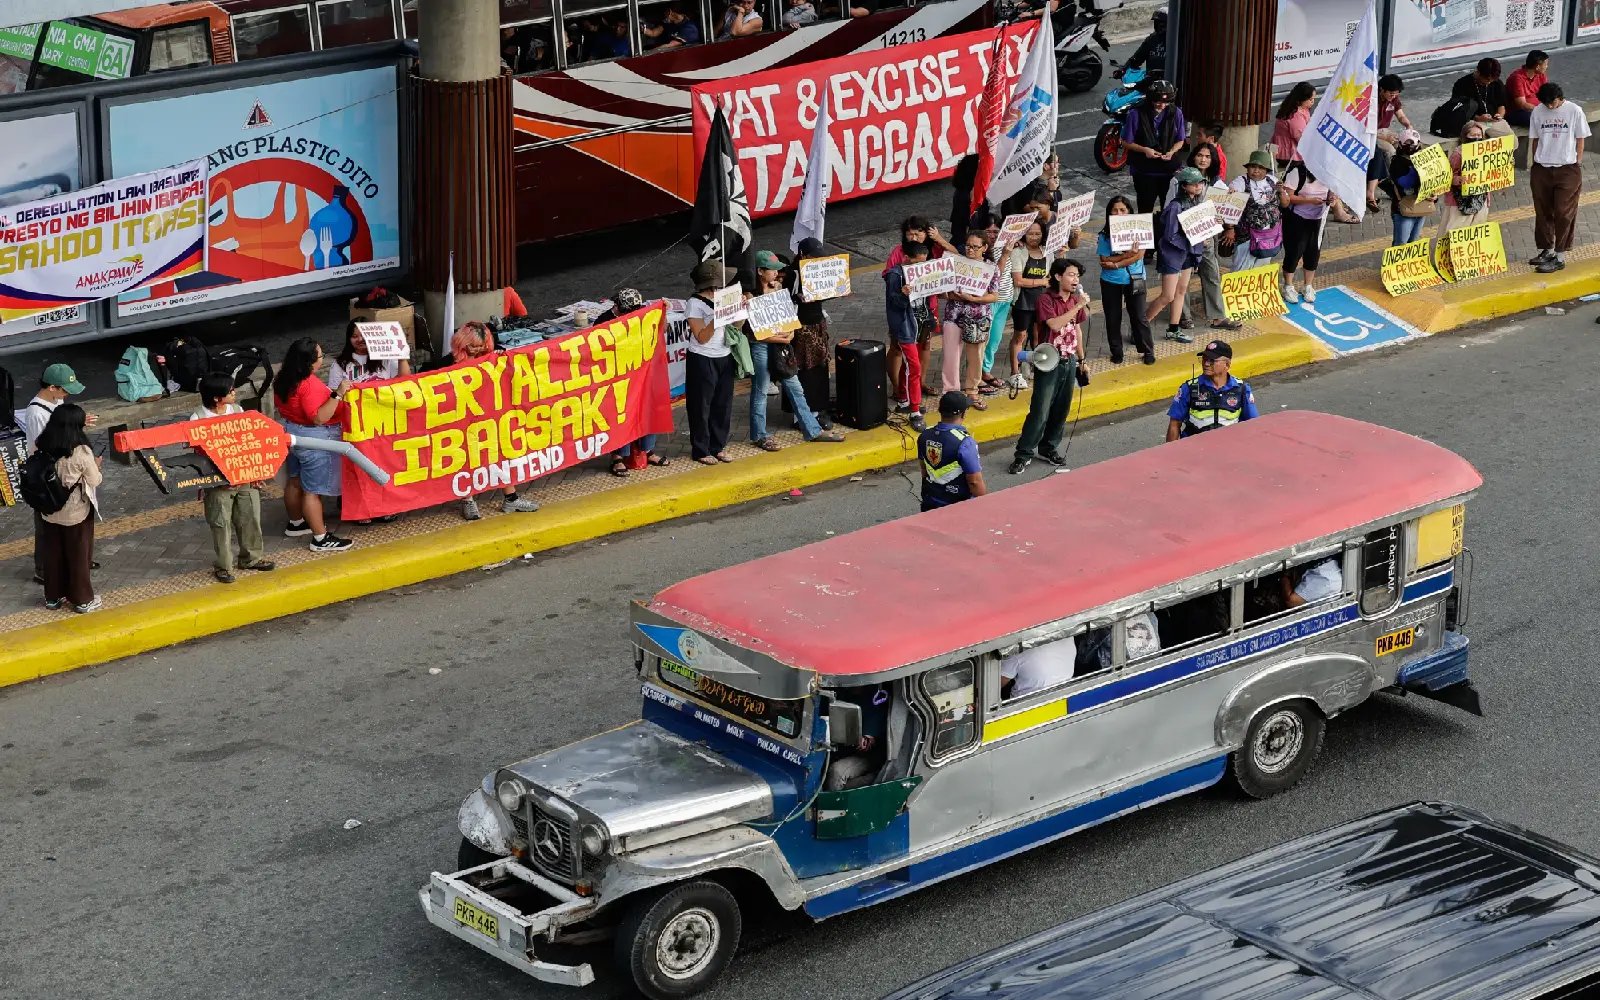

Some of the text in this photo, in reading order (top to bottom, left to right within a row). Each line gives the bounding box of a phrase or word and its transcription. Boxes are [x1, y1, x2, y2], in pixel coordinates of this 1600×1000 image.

[48, 26, 67, 45] NIA
[73, 32, 98, 53] GMA
[880, 27, 926, 48] 14213
[101, 45, 123, 75] 6A
[1299, 49, 1313, 59] HIV
[699, 84, 782, 139] VAT
[797, 78, 832, 131] &
[831, 49, 961, 120] EXCISE
[739, 84, 1016, 212] TANGGALI
[208, 136, 379, 199] ANG PLASTIC DITO
[1462, 160, 1480, 171] ANG
[1462, 173, 1477, 185] NG
[16, 191, 115, 223] DEREGULATION
[117, 183, 146, 201] LAW
[66, 211, 90, 231] NG
[93, 198, 152, 225] BILIHIN
[1111, 232, 1153, 243] TANGGALIN
[1450, 241, 1485, 258] THE OIL
[0, 227, 103, 275] SAHOD
[1382, 242, 1428, 268] UNBUNDLE
[907, 258, 955, 283] BUSINA
[1222, 270, 1279, 294] BUY-BACK
[1381, 268, 1397, 283] OIL
[814, 280, 834, 291] IRAN
[920, 279, 939, 291] PRICE
[1225, 290, 1280, 311] PETRON
[342, 309, 664, 442] IMPERYALISMO
[190, 417, 253, 441] US-MARCOS
[392, 378, 630, 487] IBAGSAK!
[206, 432, 256, 451] Sanhi sa
[265, 436, 279, 447] ng
[225, 452, 280, 470] PRESYO NG
[452, 432, 610, 498] CONTEND UP
[0, 445, 14, 473] SAHOD
[8, 473, 24, 503] ITAAS!
[213, 475, 223, 483] PL
[231, 464, 275, 484] LANGIS!
[1387, 544, 1397, 594] VIVENCIO
[1394, 630, 1411, 647] 446
[456, 902, 496, 934] PKR 446
